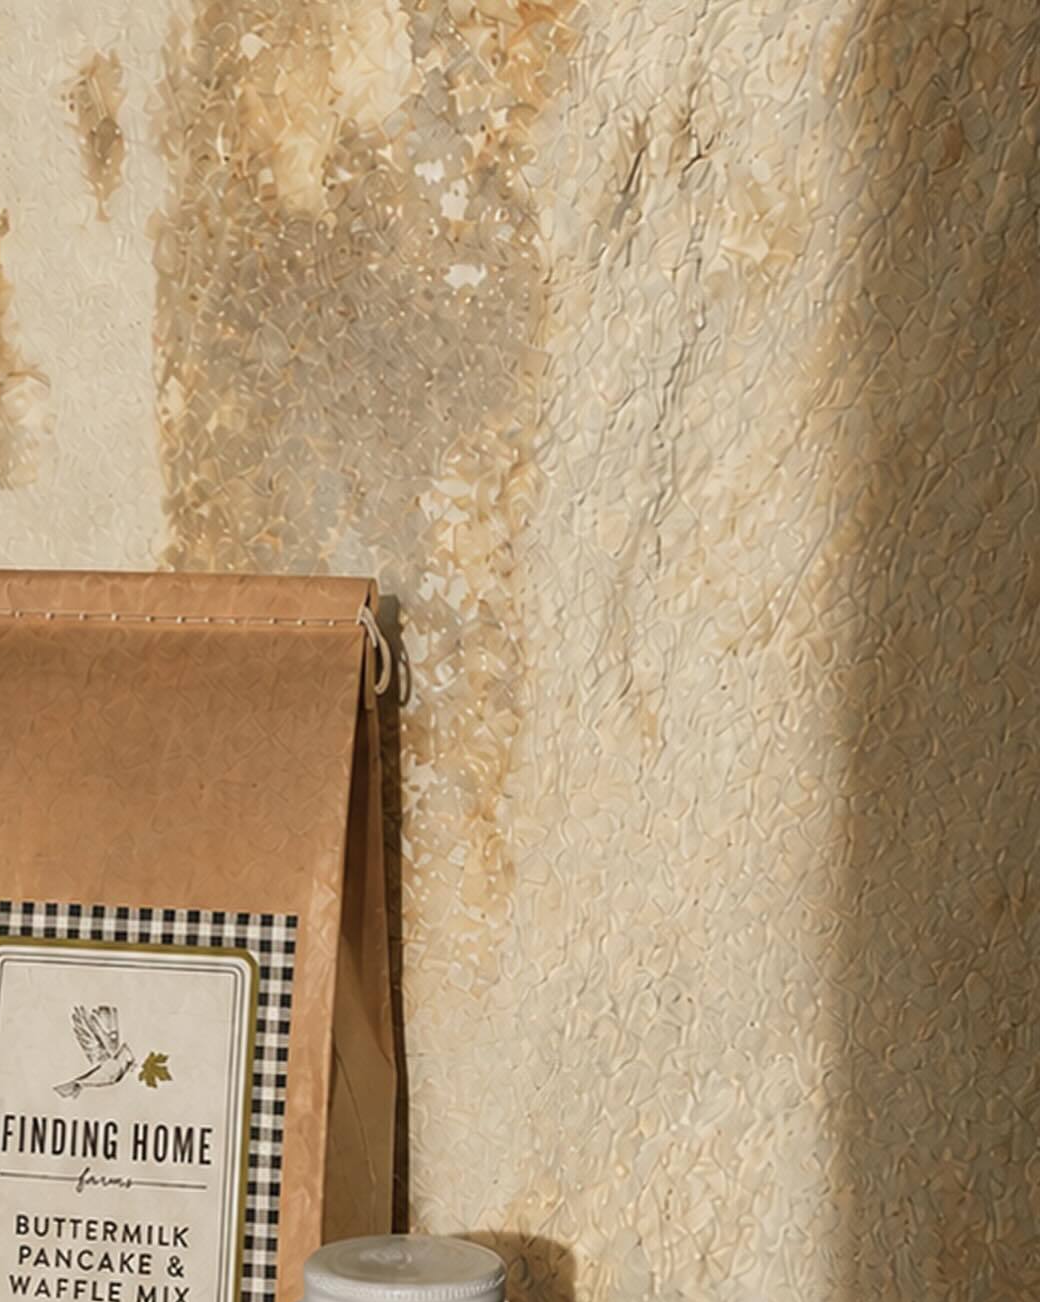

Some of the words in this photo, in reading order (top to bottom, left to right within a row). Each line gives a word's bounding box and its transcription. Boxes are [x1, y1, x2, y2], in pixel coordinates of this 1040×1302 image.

[0, 1114, 119, 1160] FINDING
[132, 1123, 213, 1165] HOME
[76, 1167, 133, 1193] farms
[15, 1214, 189, 1248] BUTTERMILK
[18, 1245, 152, 1275] PANCAKE
[166, 1255, 184, 1278] &
[9, 1274, 122, 1302] WAFFLE
